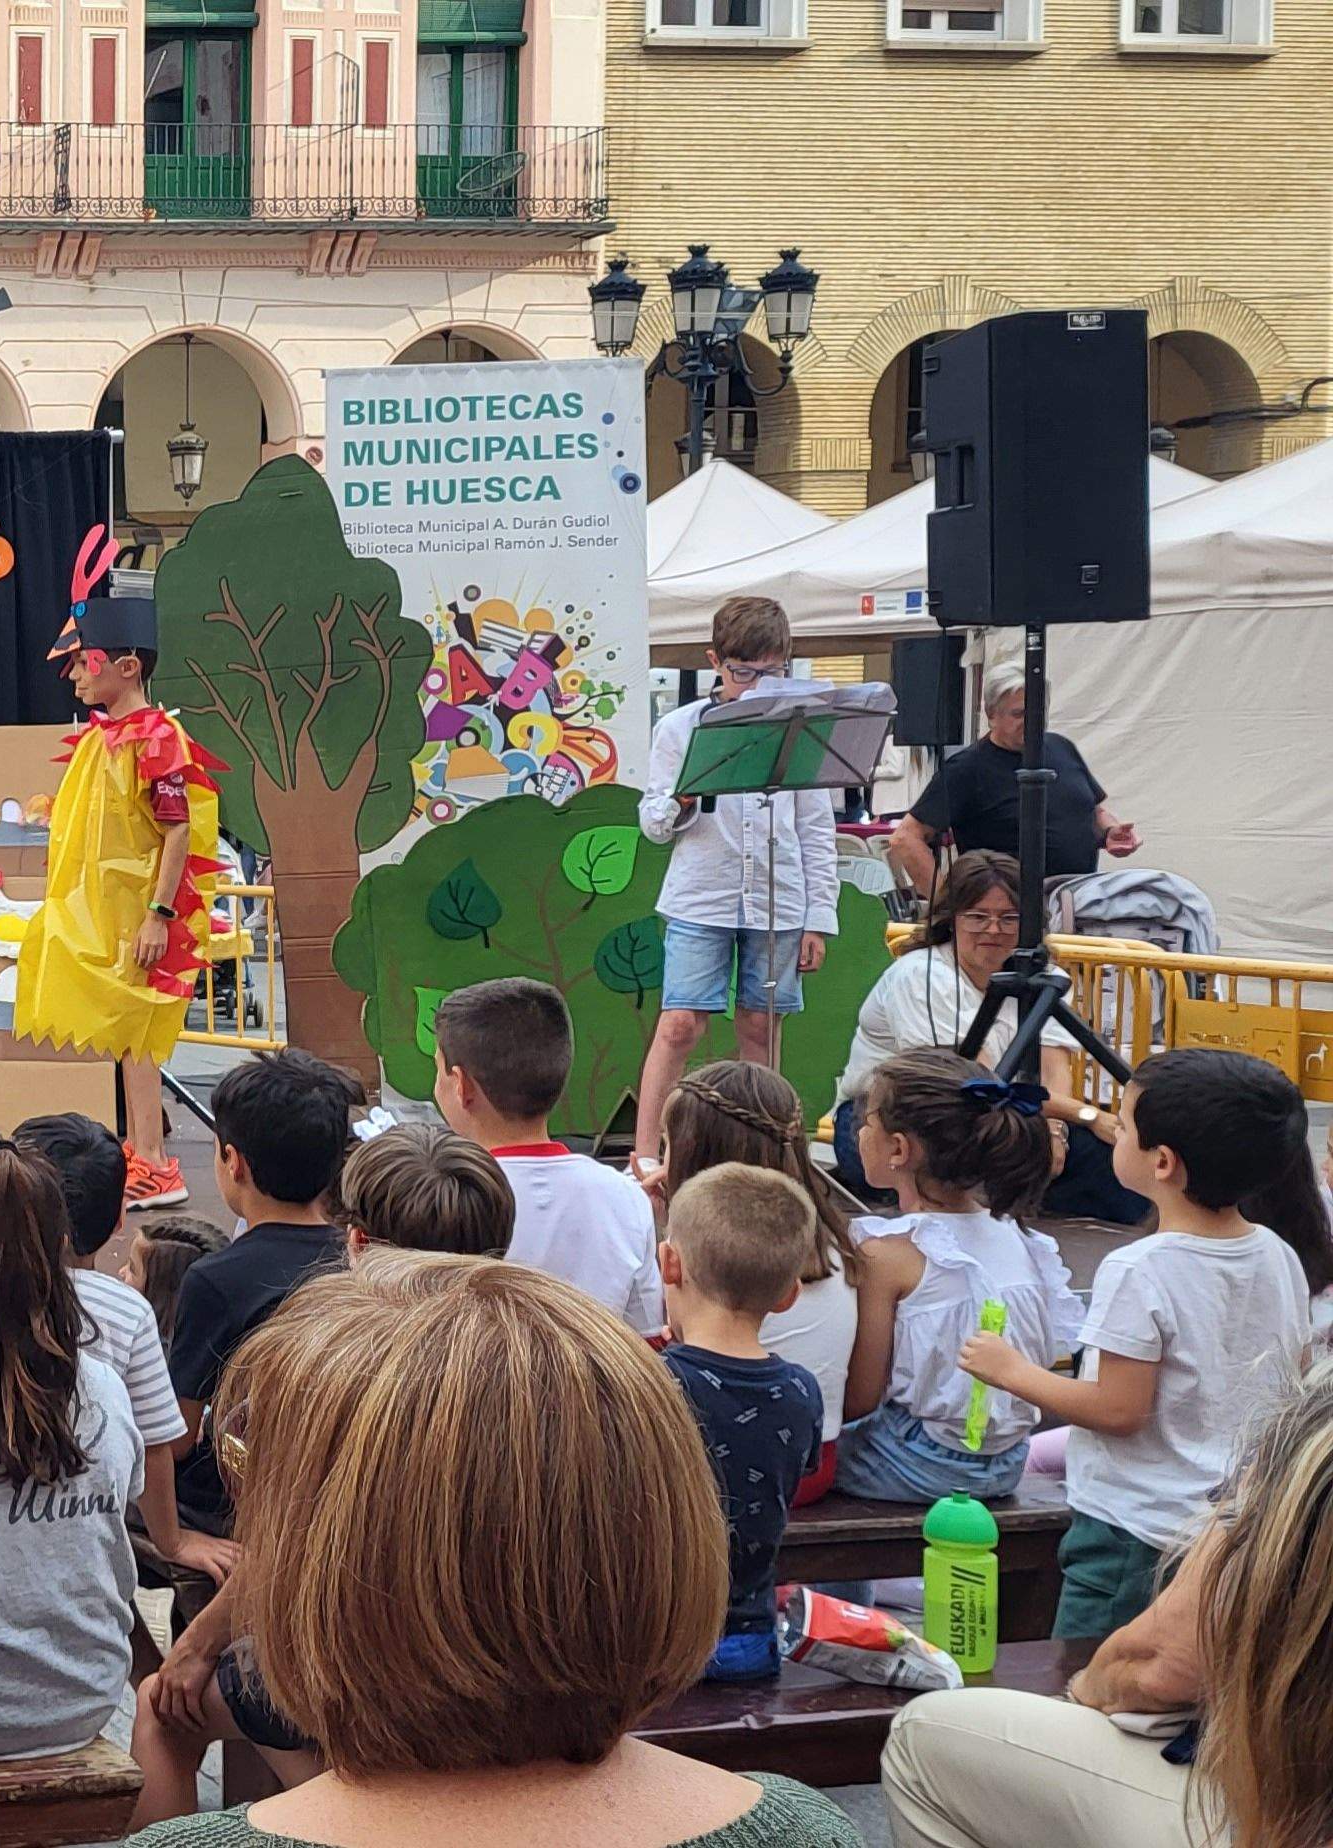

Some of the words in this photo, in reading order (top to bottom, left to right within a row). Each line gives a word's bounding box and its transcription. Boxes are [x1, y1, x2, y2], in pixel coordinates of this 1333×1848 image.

[343, 392, 584, 426] BIBLIOTECAS
[343, 433, 599, 466] MUNICIPALES
[344, 480, 392, 507] DE
[406, 475, 562, 505] HUESCA
[343, 521, 413, 536] Biblioteca
[418, 518, 490, 534] Municipal
[493, 518, 508, 530] A.
[512, 515, 557, 530] Durán
[562, 514, 610, 528] Gudiol
[418, 539, 490, 554] Municipal
[494, 536, 545, 550] Ramón
[549, 536, 563, 549] J.
[567, 534, 620, 548] Sender
[950, 1583, 965, 1656] EUSKADI
